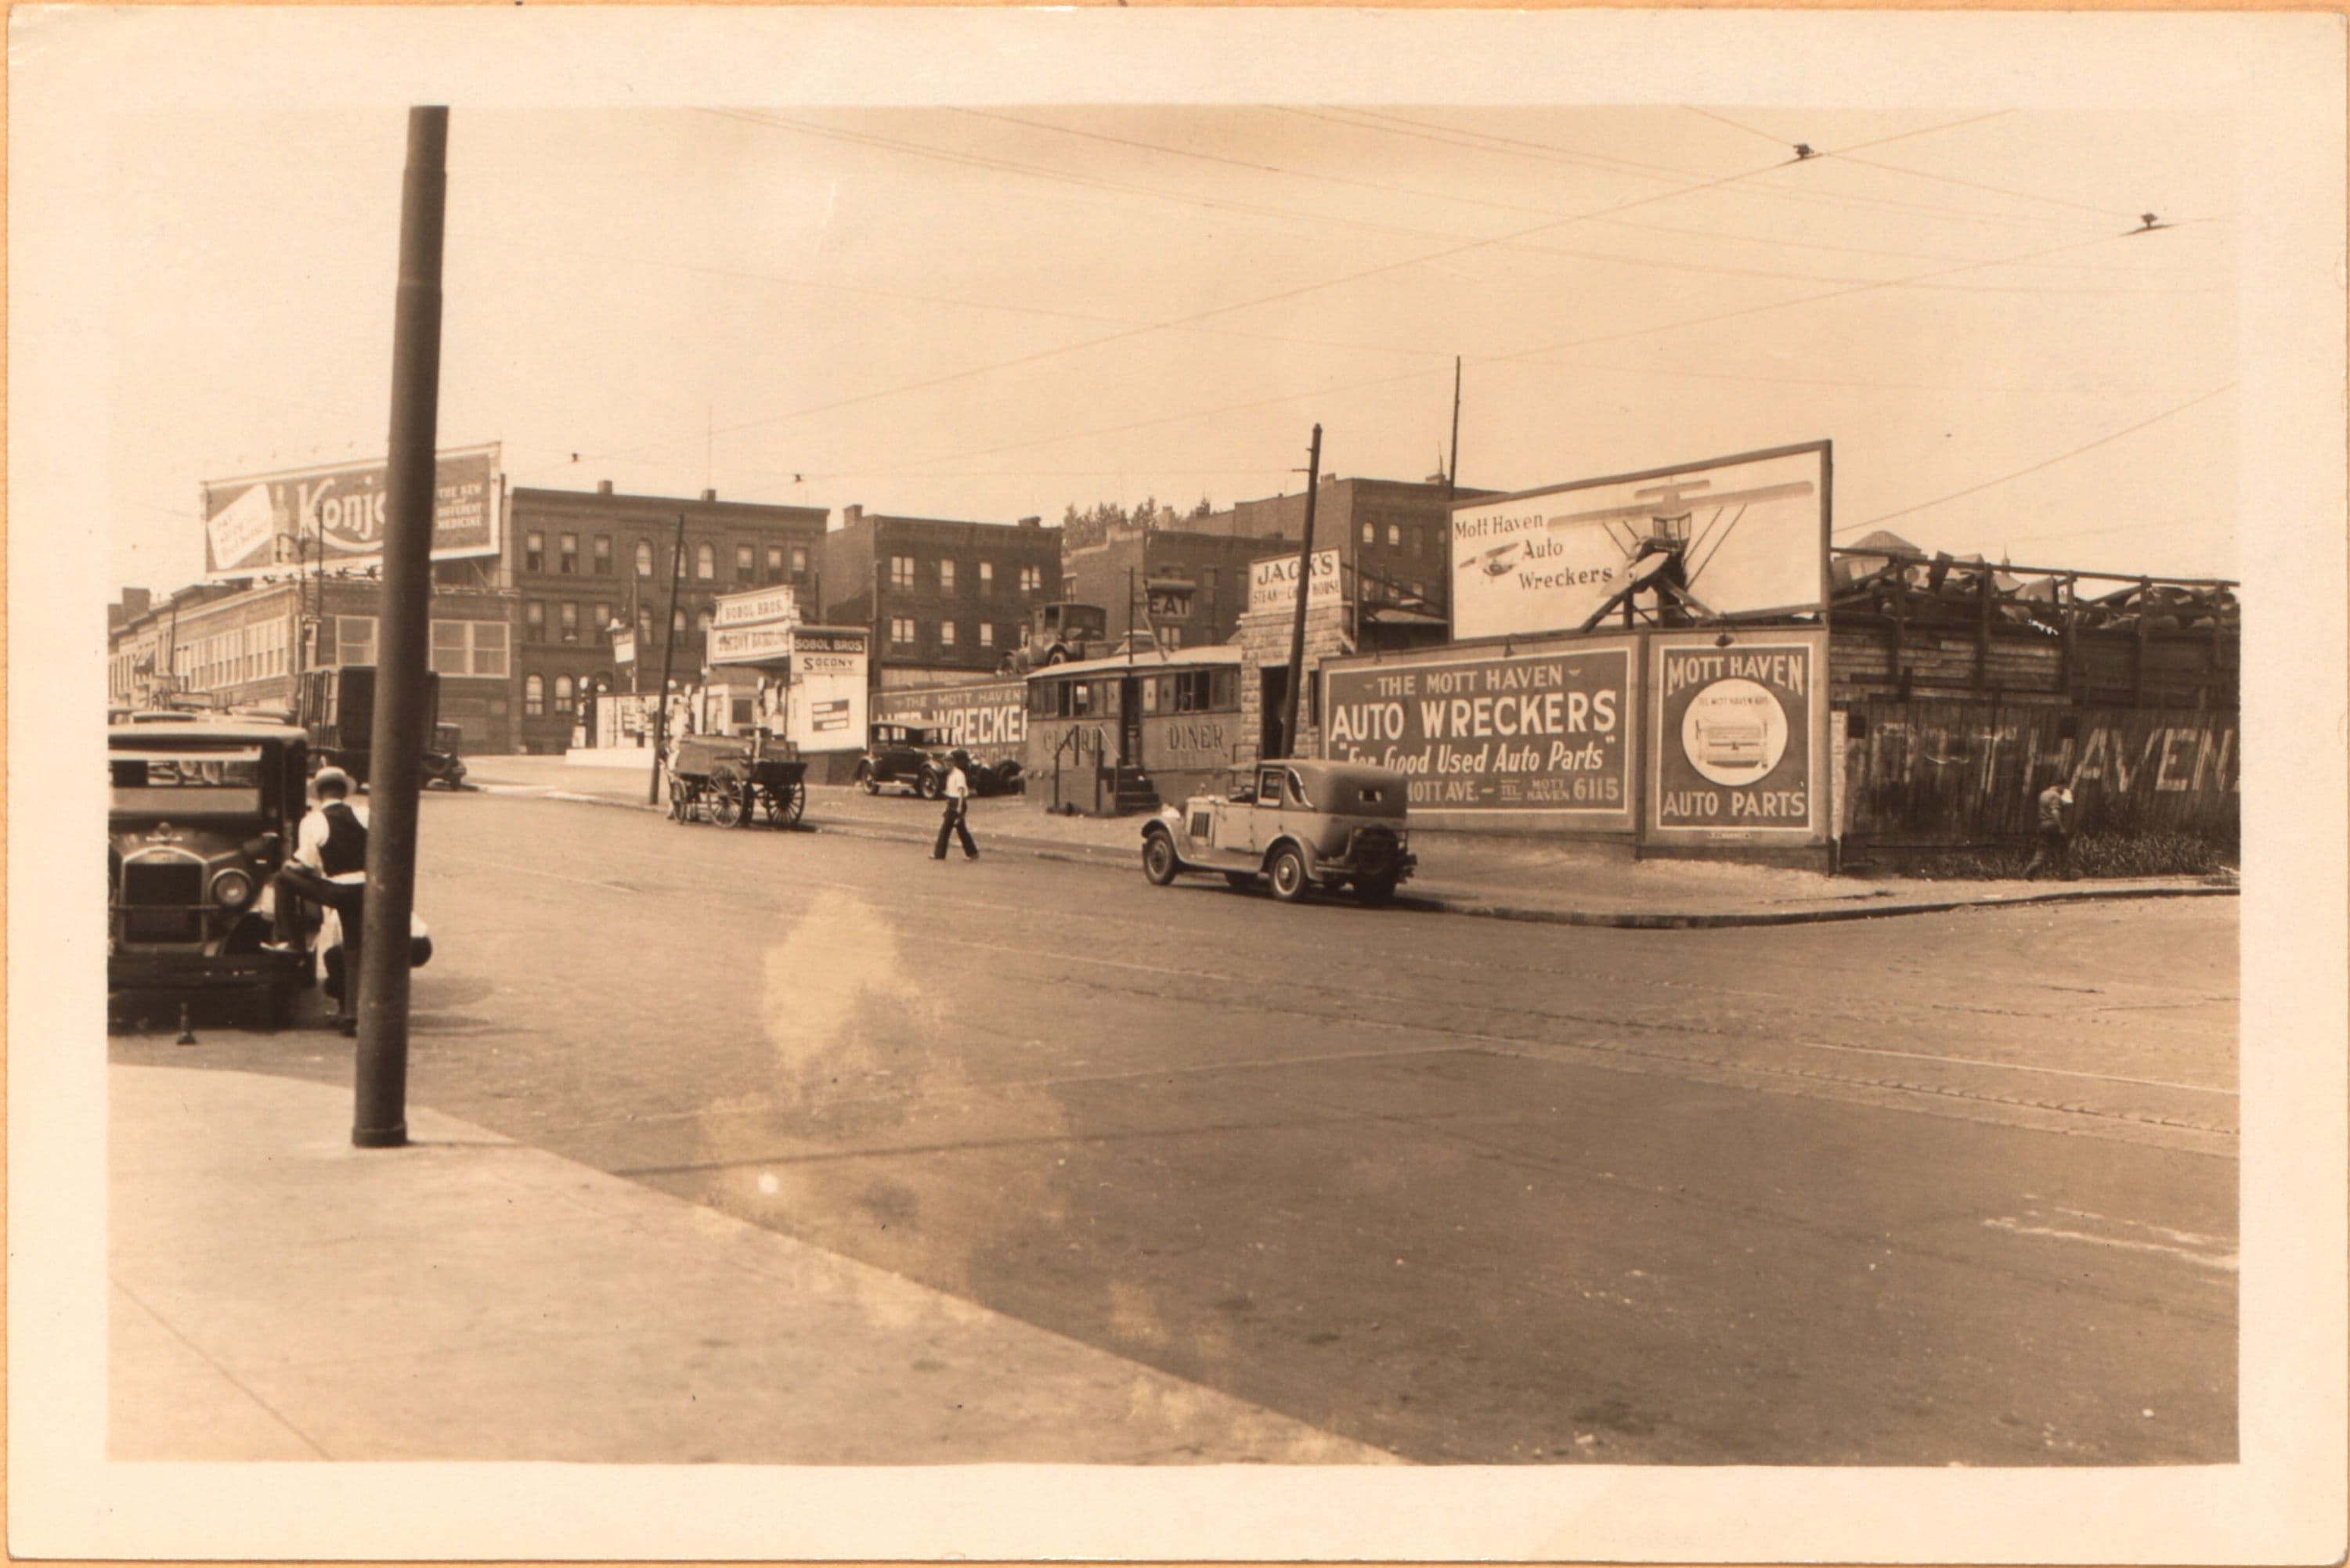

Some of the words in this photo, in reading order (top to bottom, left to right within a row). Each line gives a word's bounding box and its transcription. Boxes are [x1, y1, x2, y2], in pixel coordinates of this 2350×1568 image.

[1455, 517, 1488, 540] Mott
[1493, 514, 1543, 535] Haven
[1522, 538, 1563, 561] Auto
[1518, 566, 1613, 591] Wreckers
[1149, 594, 1191, 615] EAT
[795, 638, 831, 651] SOBOL
[803, 657, 854, 670] SOCONY
[1667, 655, 1725, 697] MOTT
[1730, 654, 1803, 696] HAVEN
[1377, 676, 1416, 697] THE
[1425, 670, 1478, 694] MOTT
[1486, 664, 1562, 690] HAVEN
[906, 695, 928, 708] THE
[937, 692, 973, 705] MOTT
[980, 689, 1021, 703] HAVEN
[1330, 701, 1404, 742] AUTO
[1420, 688, 1617, 739] WRECKERS
[1166, 724, 1229, 758] DINER
[1384, 744, 1431, 775] Good
[1437, 743, 1489, 774] Used
[1492, 742, 1540, 773] Auto
[2022, 727, 2233, 793] HAVEN
[1526, 790, 1570, 802] HAVEN
[1532, 778, 1564, 790] MOTT
[1573, 777, 1619, 801] 6115
[1662, 792, 1719, 816] AUTO
[1731, 791, 1806, 816] PARTS
